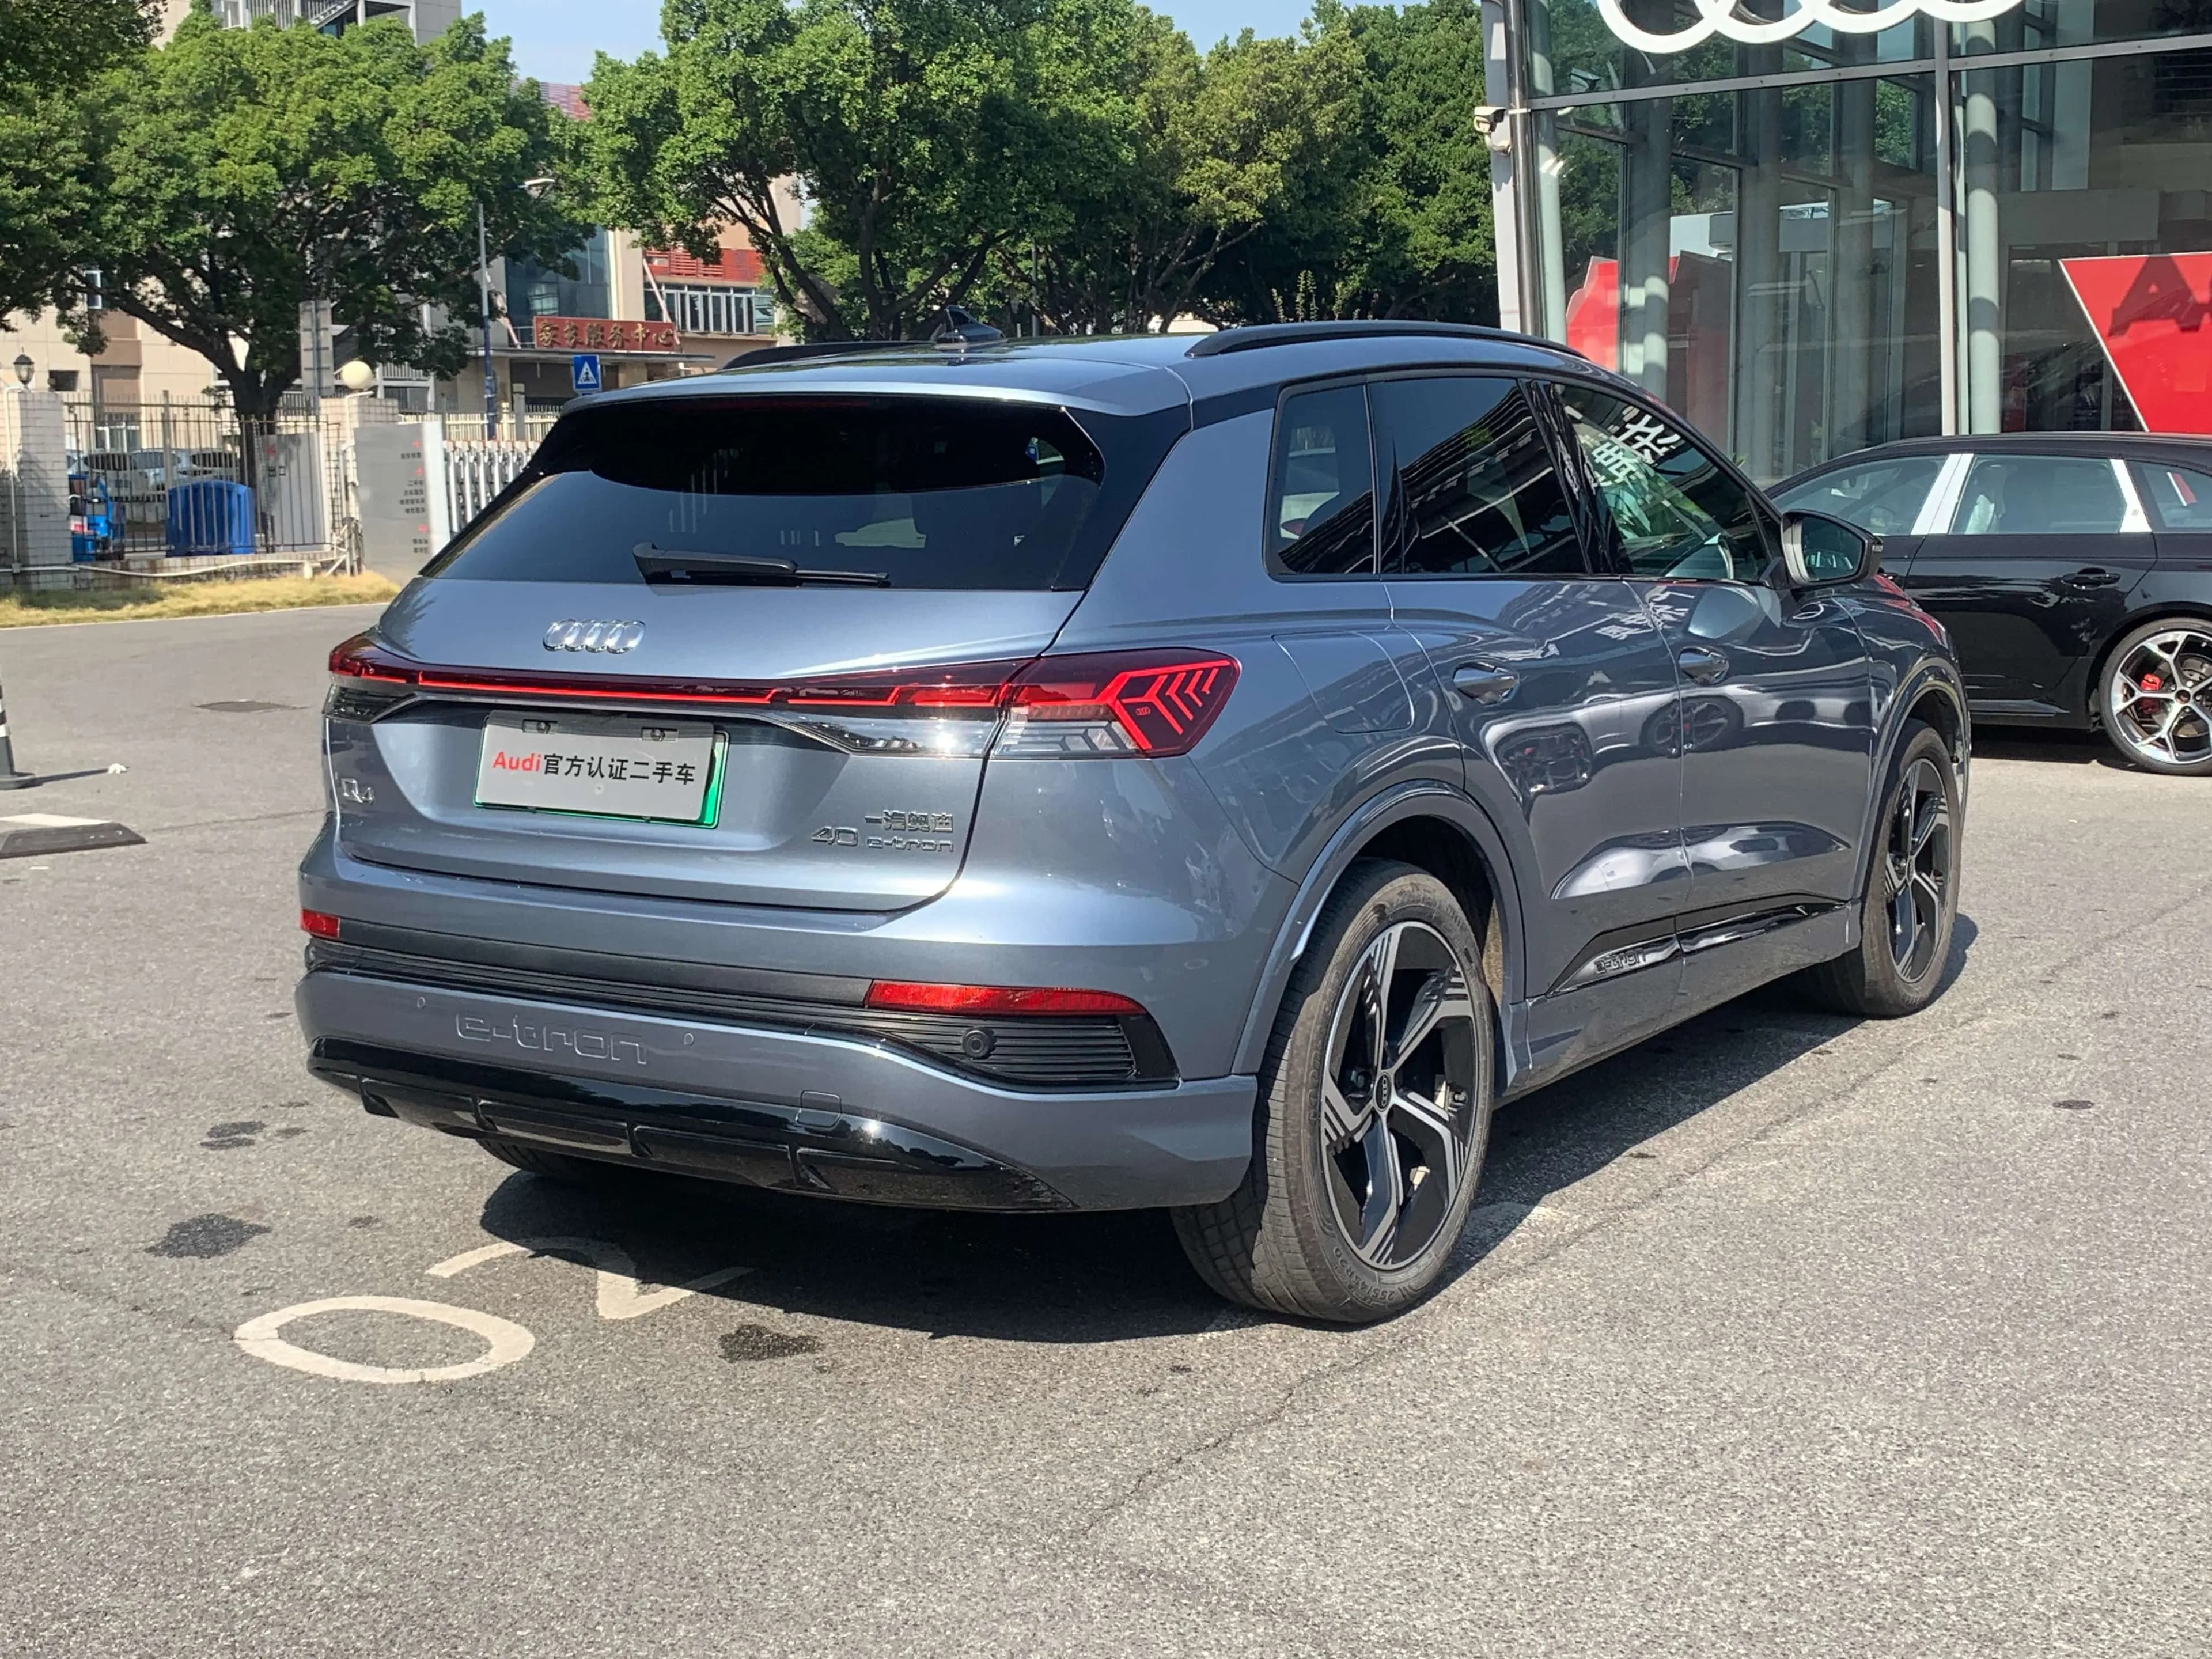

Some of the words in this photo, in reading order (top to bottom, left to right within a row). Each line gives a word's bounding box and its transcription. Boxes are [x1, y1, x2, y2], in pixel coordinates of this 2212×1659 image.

[341, 777, 374, 805] Q4
[864, 809, 954, 833] 一汽奥迪
[811, 825, 859, 847] 40
[866, 836, 955, 853] e-tron
[1594, 948, 1647, 975] e-tron
[456, 1014, 647, 1065] e-tron
